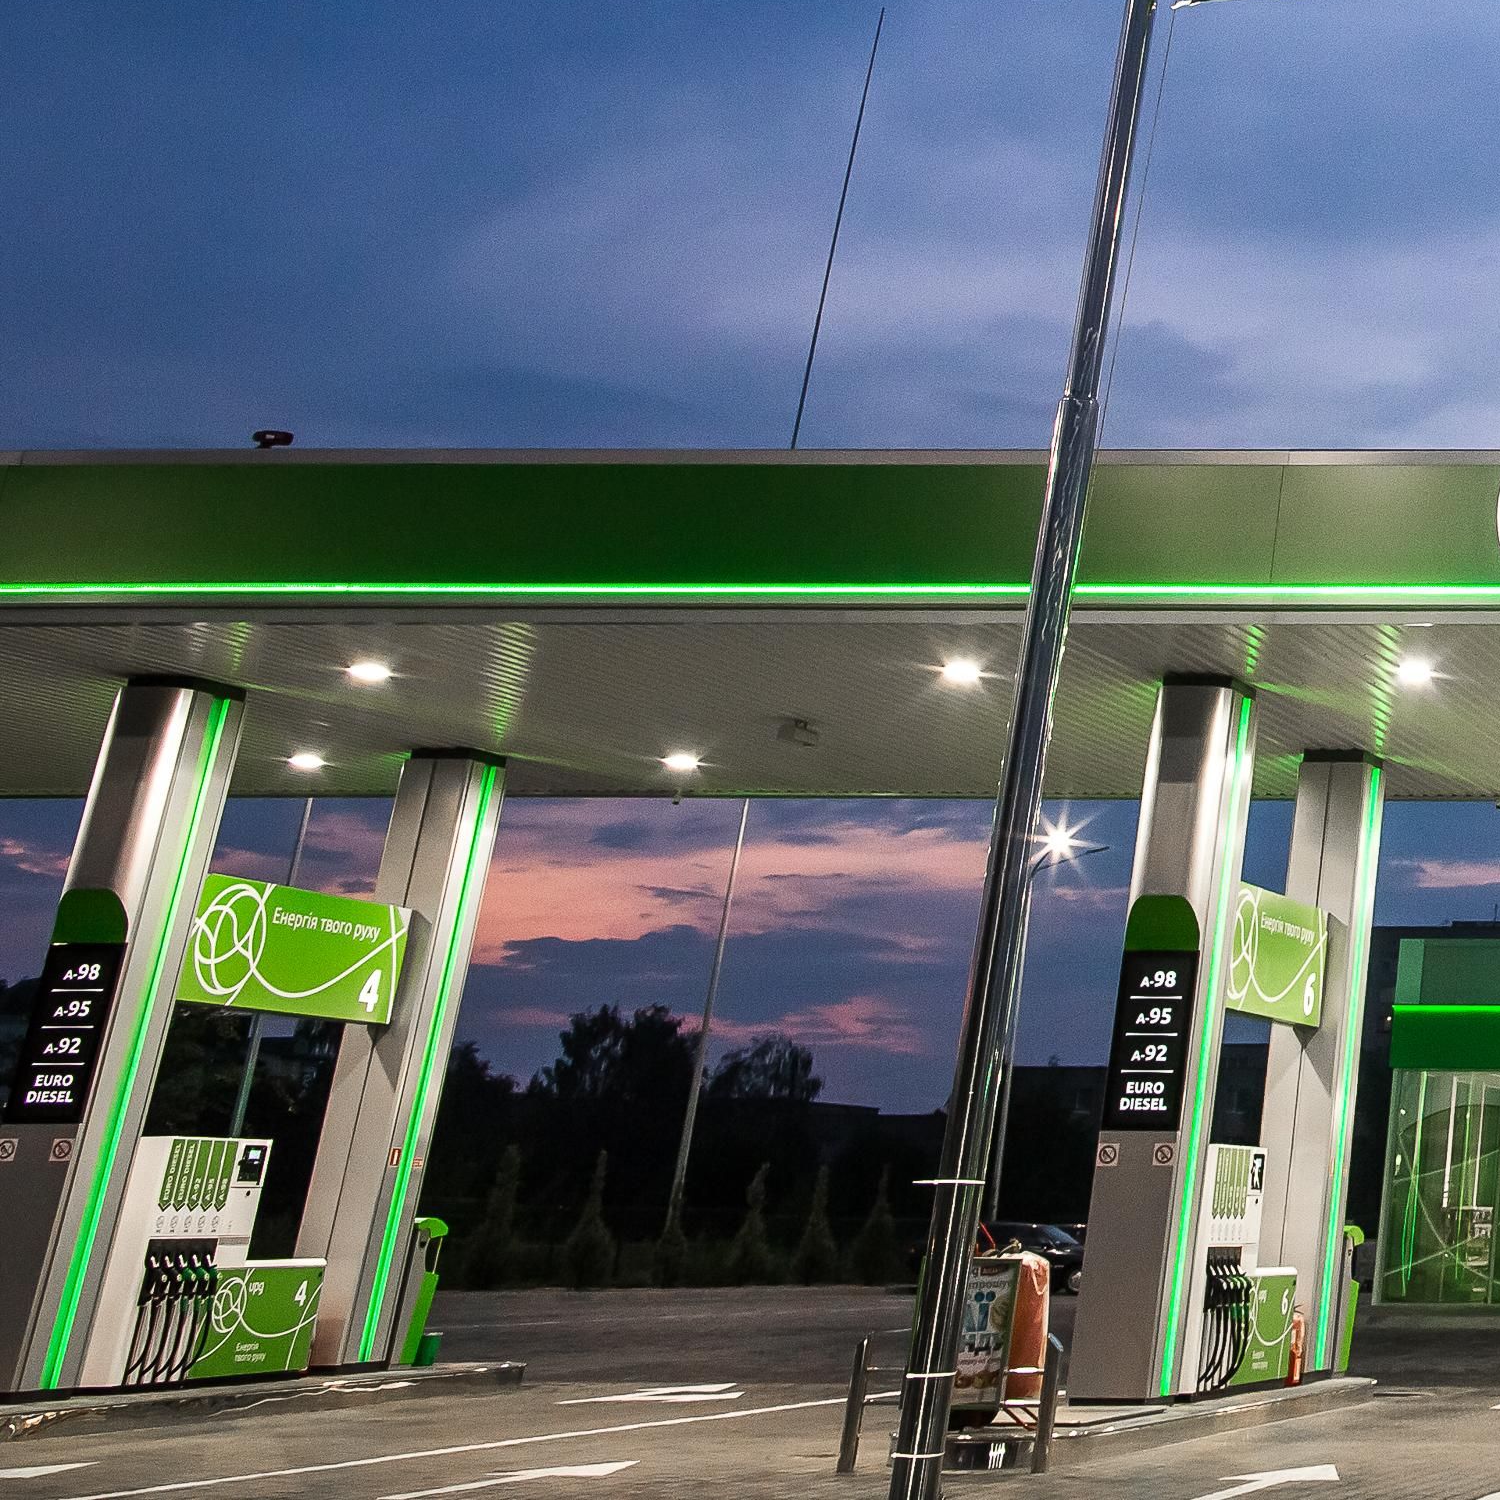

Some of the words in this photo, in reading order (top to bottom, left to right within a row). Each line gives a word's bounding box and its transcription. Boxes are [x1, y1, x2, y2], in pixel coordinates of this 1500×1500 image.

[272, 907, 317, 931] Енергія
[320, 918, 352, 935] твого
[353, 925, 381, 943] руху
[63, 964, 100, 980] A-98
[1140, 971, 1176, 987] A-98
[358, 969, 382, 1012] 4
[1303, 972, 1316, 1016] 6
[53, 1001, 91, 1017] A-95
[1136, 1008, 1172, 1024] A-95
[43, 1038, 81, 1054] A-92
[1131, 1045, 1167, 1061] A-92
[34, 1075, 73, 1086] EURO
[1126, 1082, 1164, 1094] EURO
[25, 1091, 73, 1103] DIESEL
[1120, 1098, 1167, 1110] DIESEL
[294, 1280, 308, 1307] 4
[1282, 1288, 1289, 1315] 6
